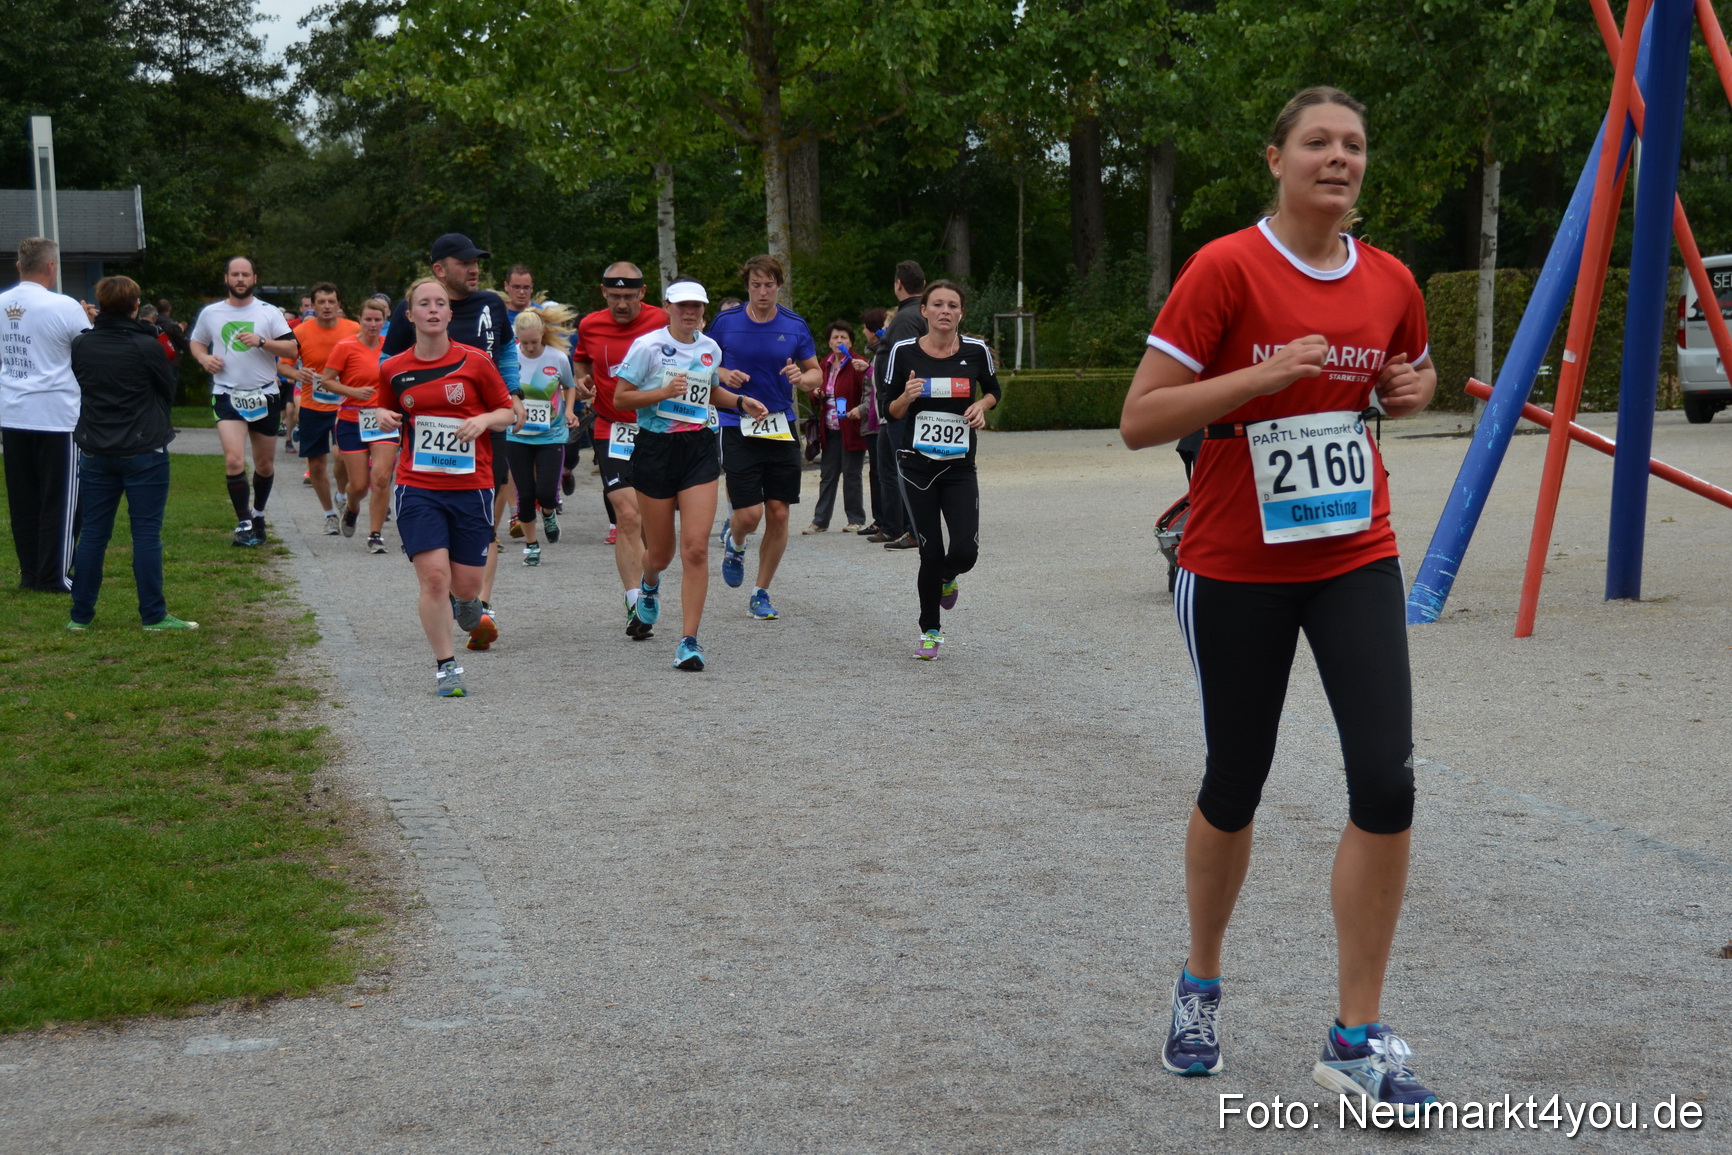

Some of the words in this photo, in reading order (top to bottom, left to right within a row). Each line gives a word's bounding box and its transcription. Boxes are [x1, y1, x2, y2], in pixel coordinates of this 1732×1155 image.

[1713, 274, 1732, 288] SE
[10, 321, 20, 330] IM
[9, 370, 28, 380] JESUS
[234, 396, 262, 410] 3031
[673, 404, 696, 416] Natalie
[751, 417, 779, 434] 241
[920, 423, 964, 444] 2392
[1252, 430, 1297, 446] PARTL
[1300, 424, 1352, 438] Neumarkt
[431, 456, 457, 466] Nicole
[1268, 440, 1366, 494] 2160
[1292, 499, 1357, 522] Christina
